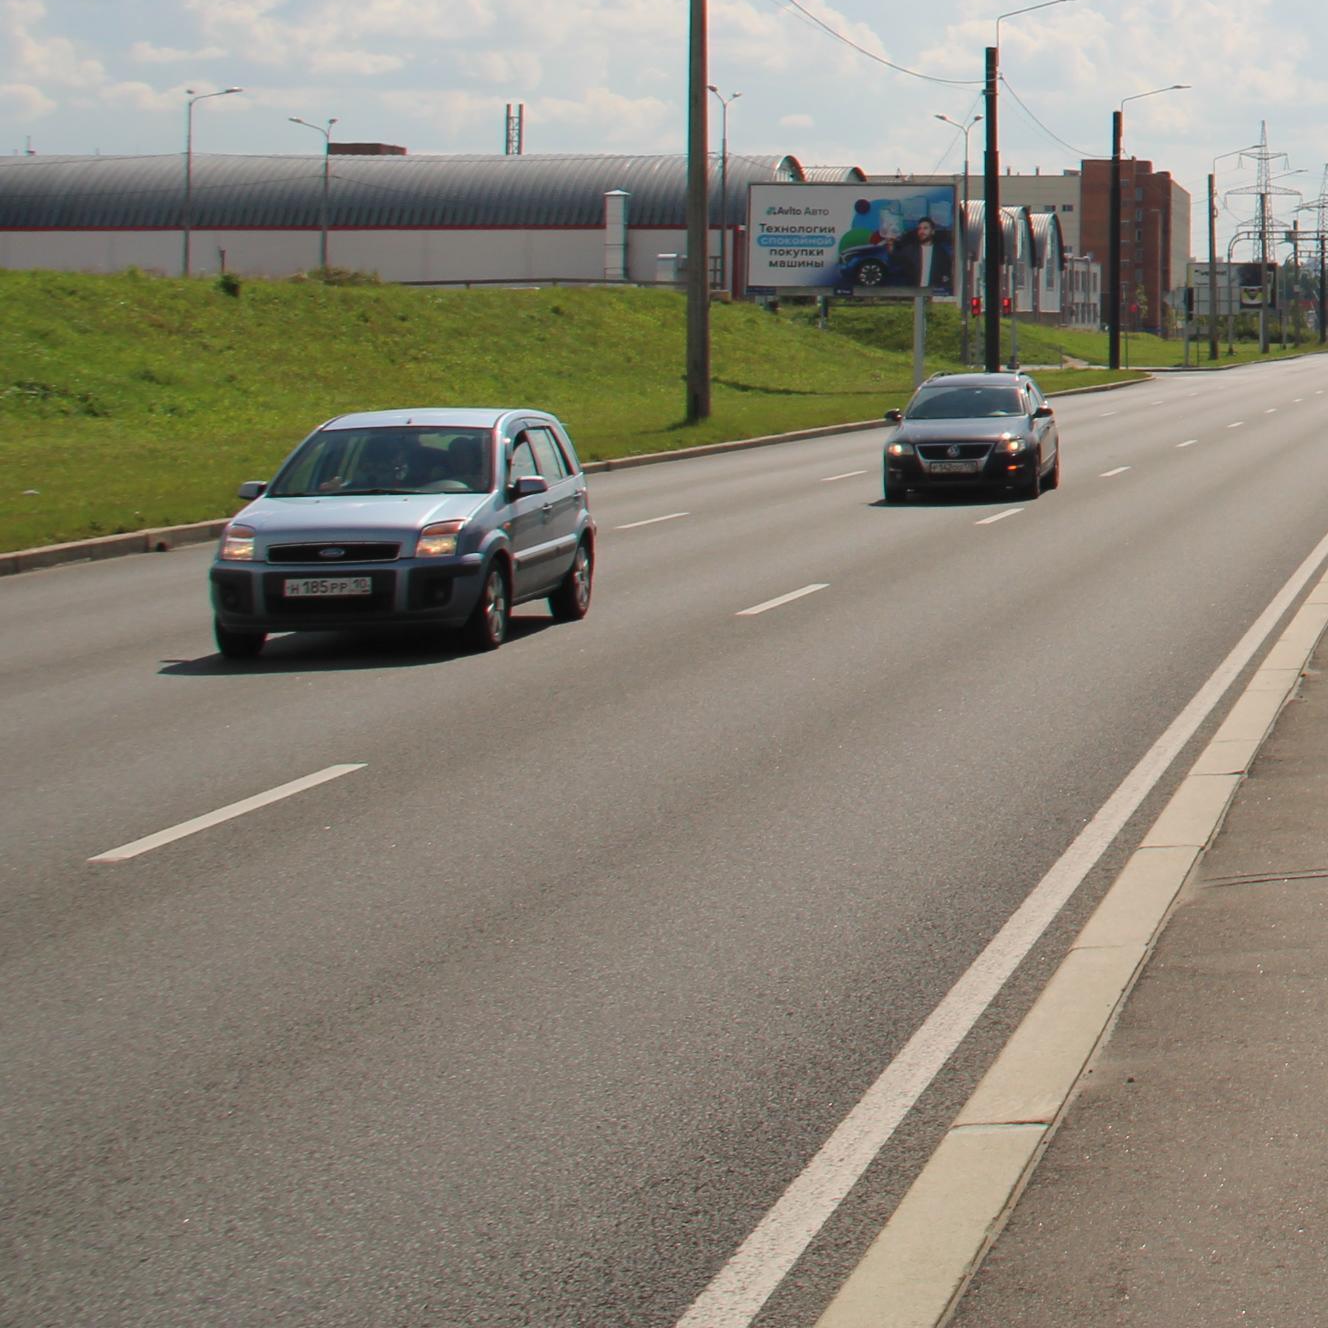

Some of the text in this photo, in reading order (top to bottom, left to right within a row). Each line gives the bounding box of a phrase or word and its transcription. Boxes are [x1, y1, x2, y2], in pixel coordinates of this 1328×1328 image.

[777, 206, 830, 216] Avito Авто
[759, 223, 836, 234] Технологии
[760, 236, 833, 246] спокойной
[769, 248, 824, 258] покупки
[768, 259, 825, 268] машины
